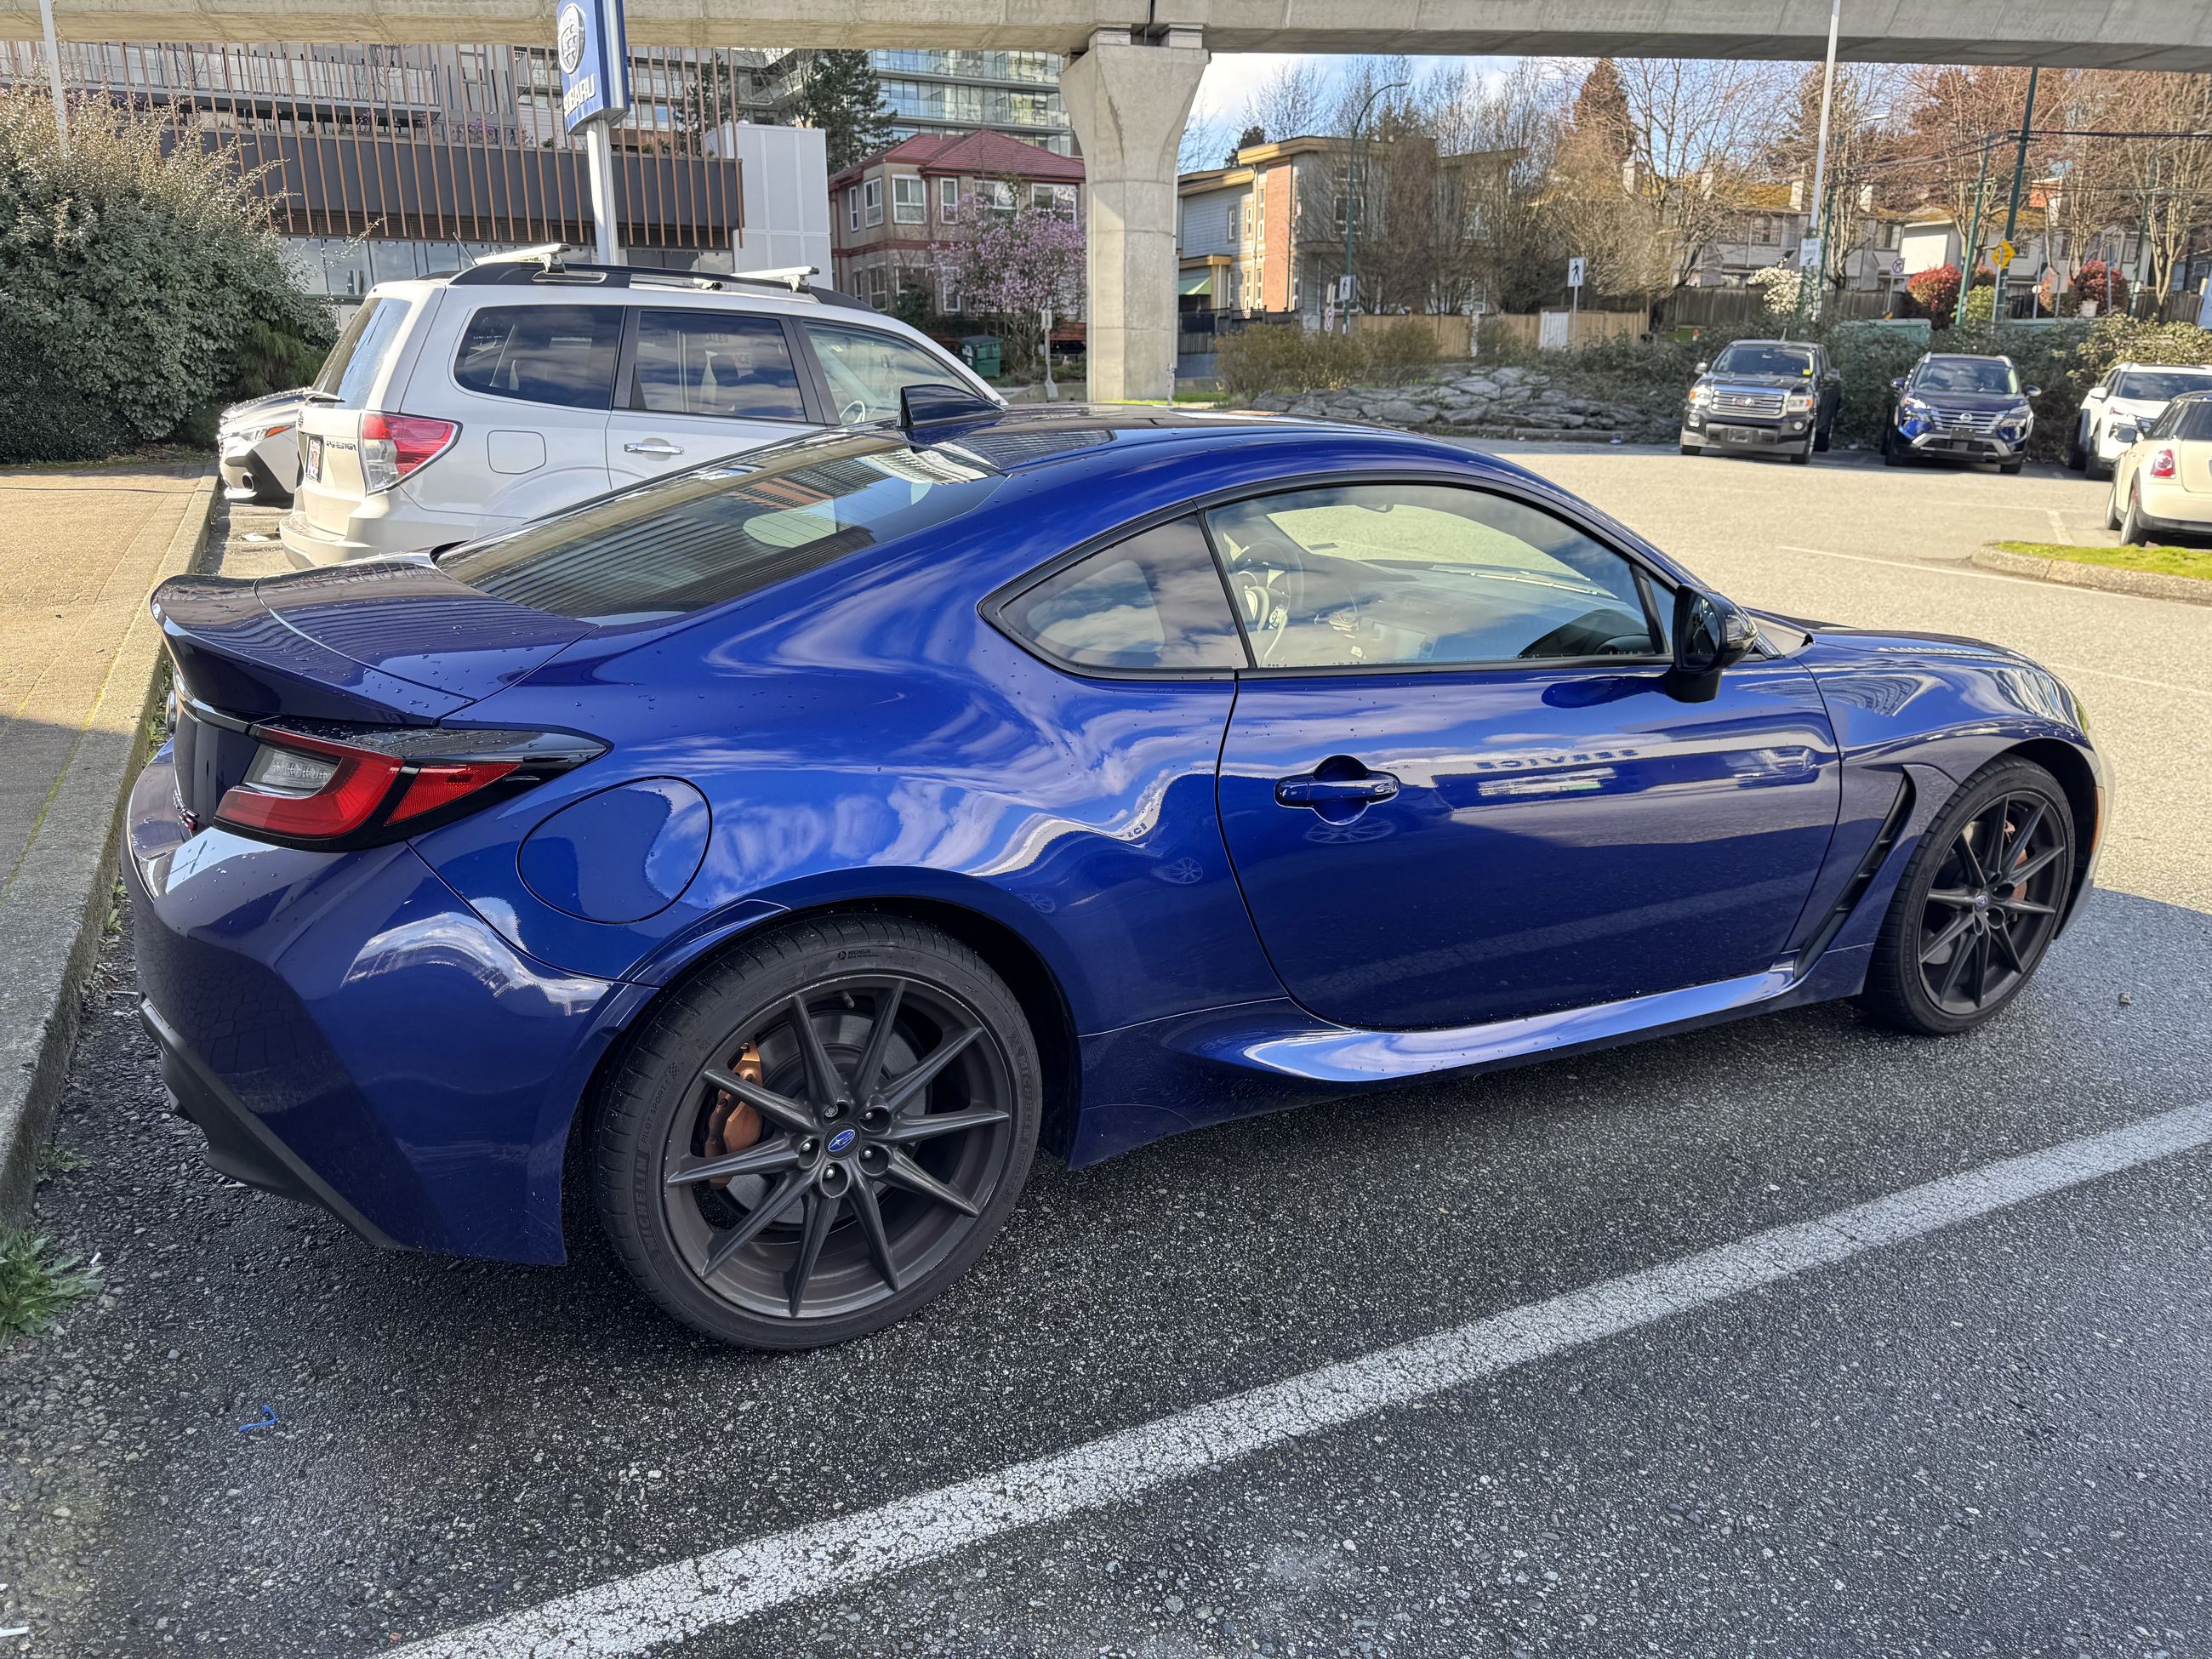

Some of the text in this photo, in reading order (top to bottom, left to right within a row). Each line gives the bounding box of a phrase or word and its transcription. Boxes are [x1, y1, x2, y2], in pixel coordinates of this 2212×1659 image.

[641, 1116, 653, 1143] PILOT
[649, 1084, 665, 1115] SPORT
[634, 1154, 658, 1252] MICHELIN
